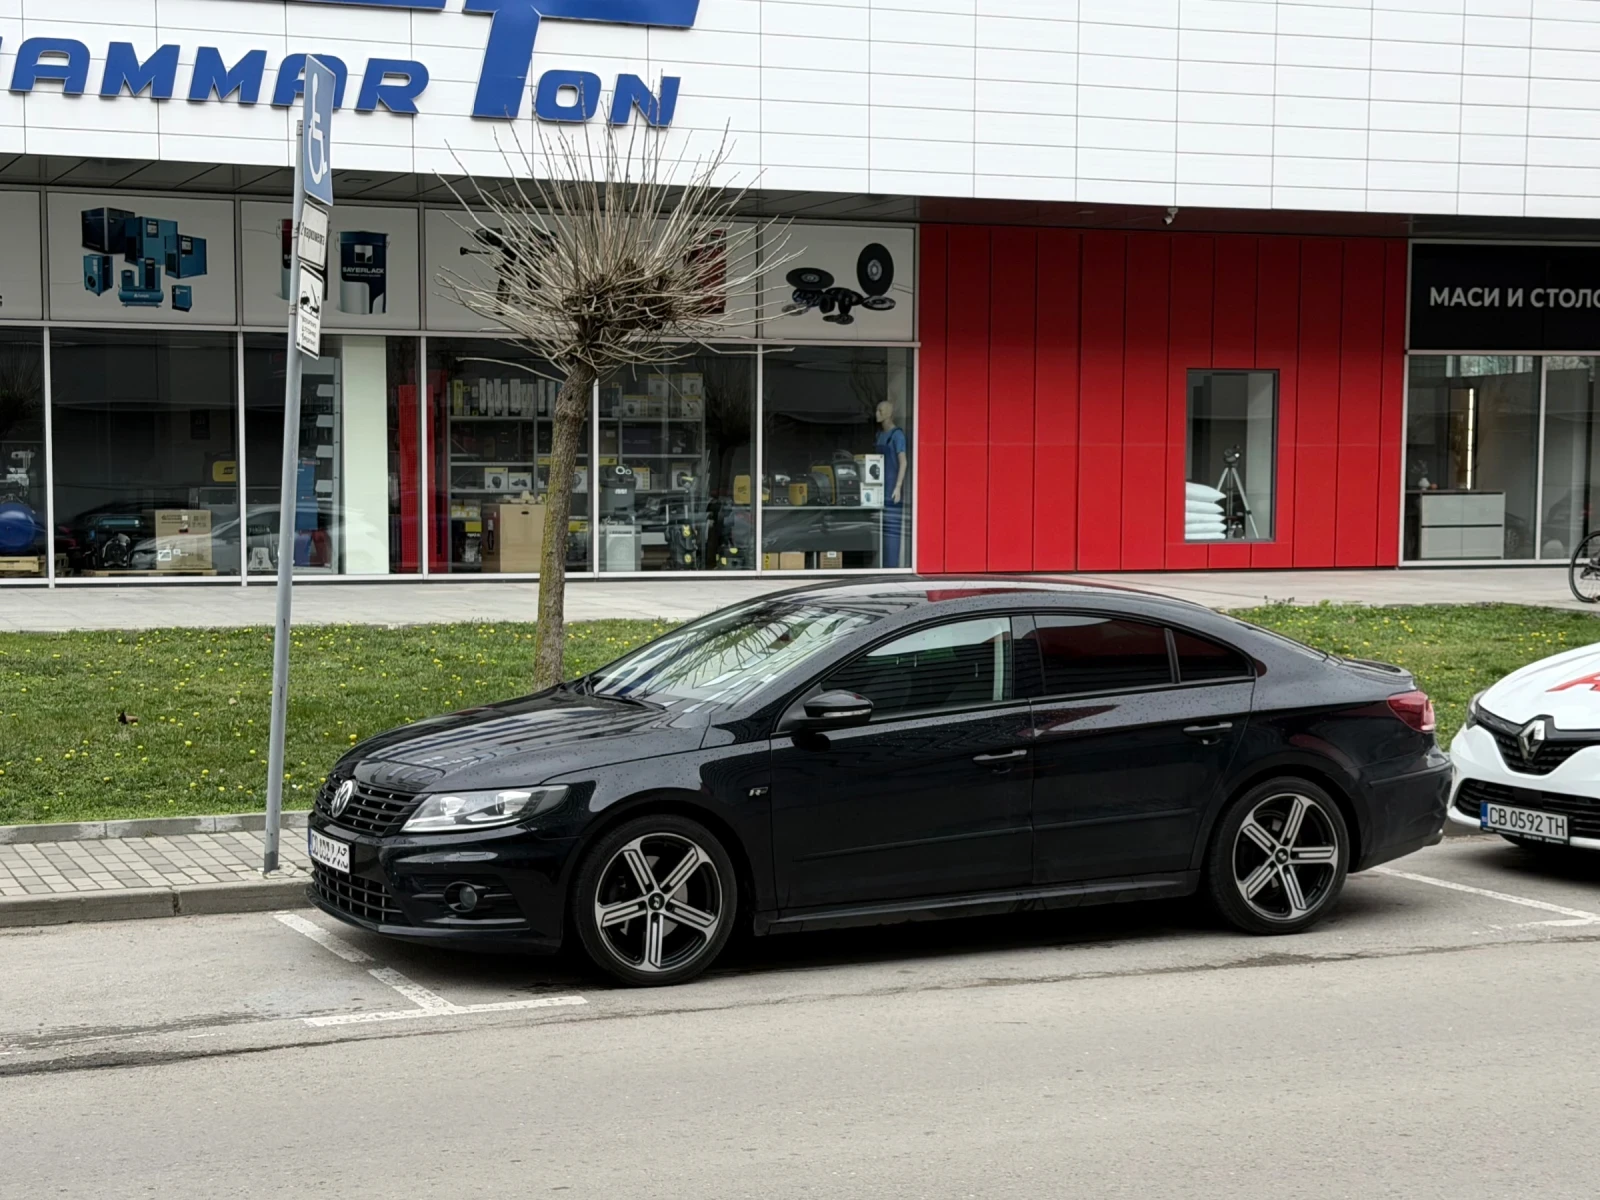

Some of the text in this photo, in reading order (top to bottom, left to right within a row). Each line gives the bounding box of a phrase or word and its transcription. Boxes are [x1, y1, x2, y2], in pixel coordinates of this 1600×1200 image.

[0, 36, 430, 114] AMMAR
[342, 266, 384, 274] SAYERLACK
[1430, 286, 1500, 307] МАСИ
[1507, 288, 1524, 307] И
[1510, 810, 1543, 833] 0592
[1546, 815, 1565, 837] TH
